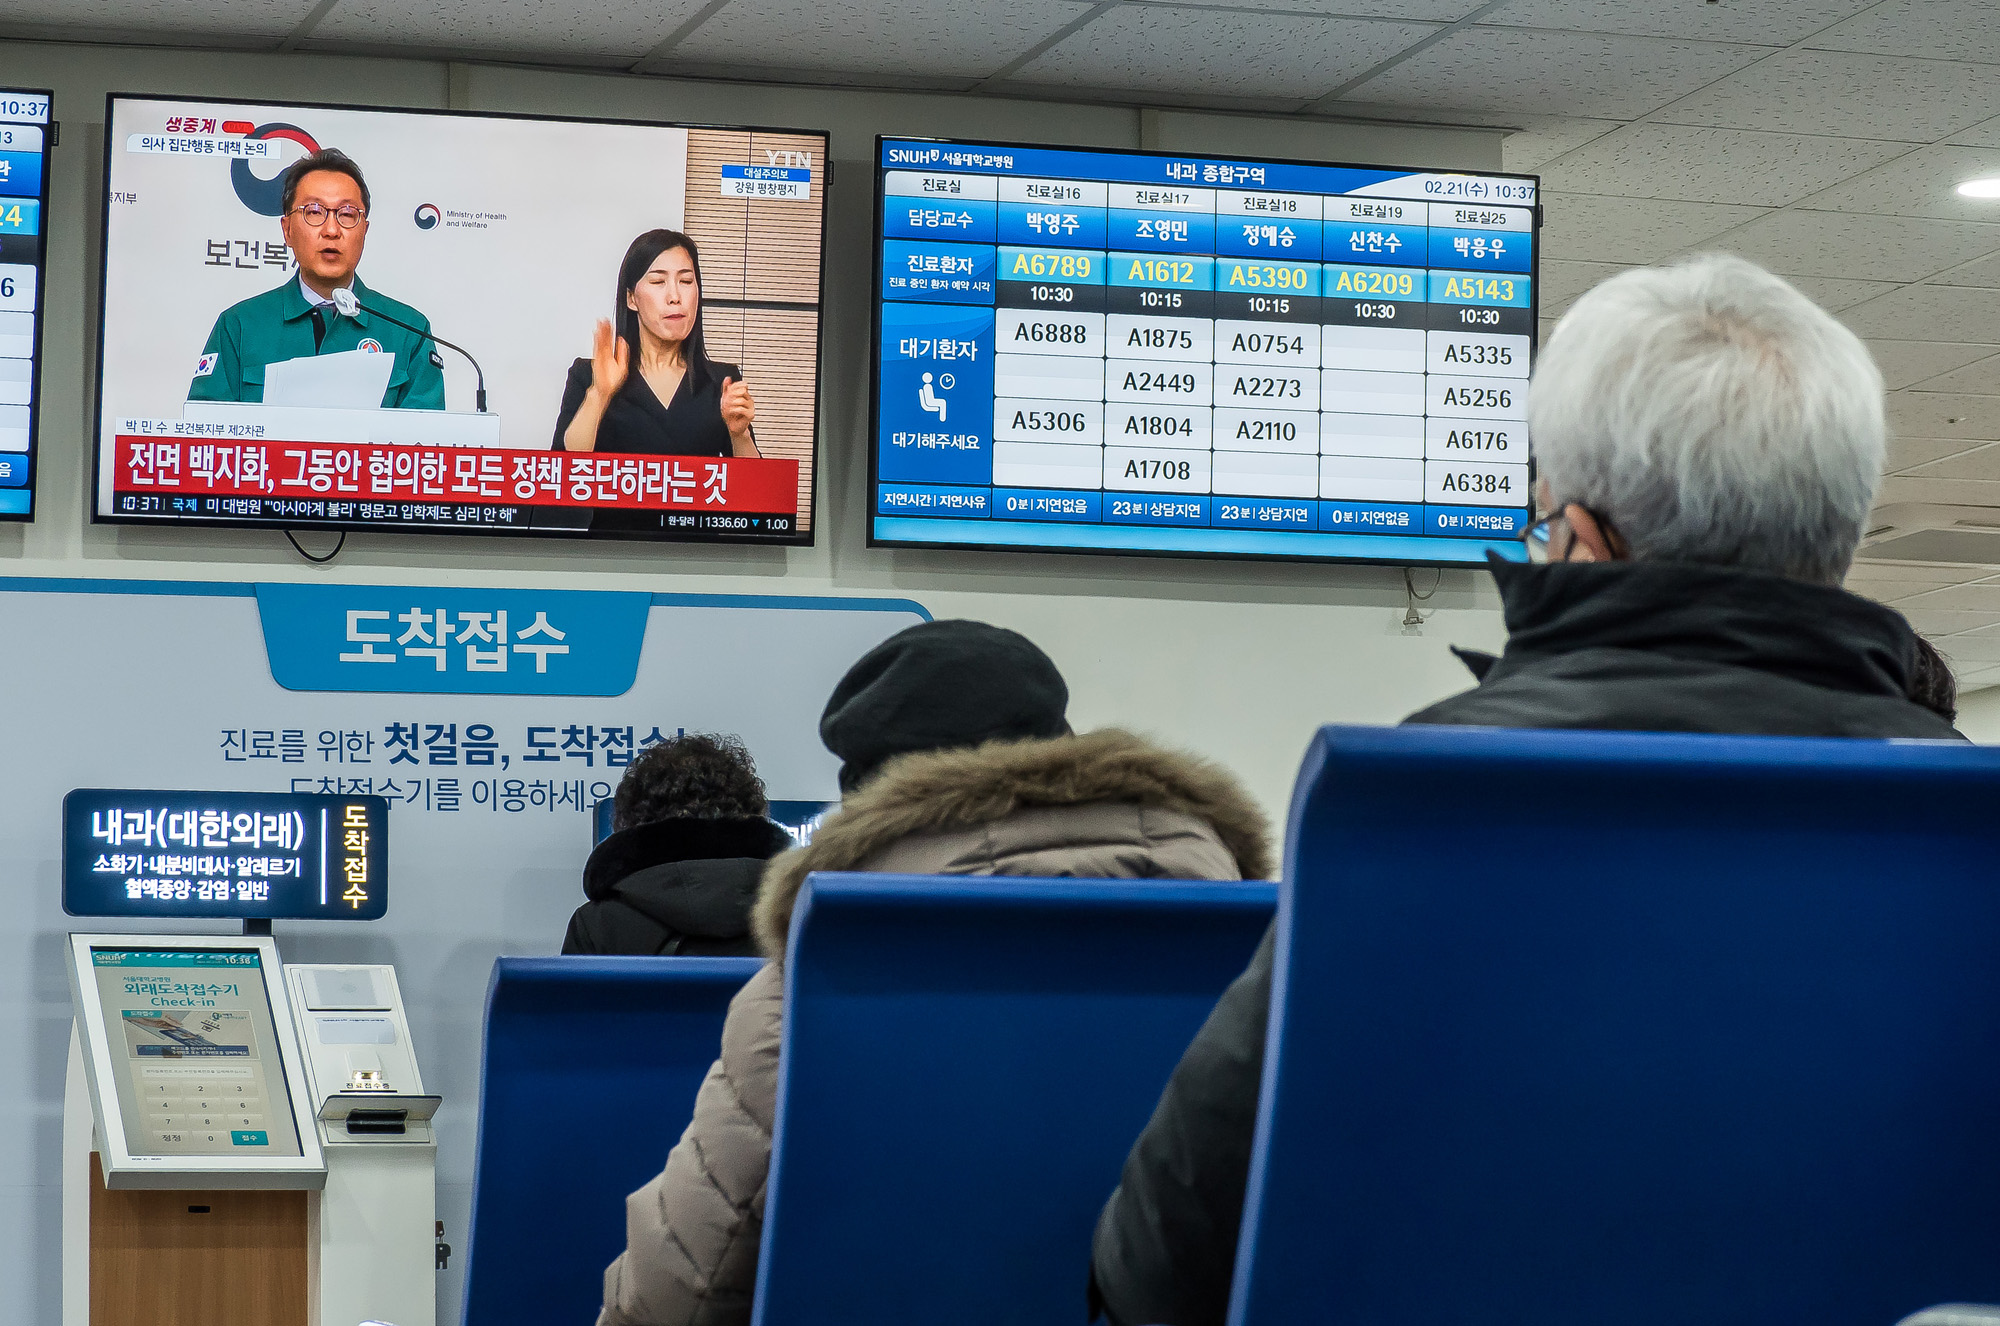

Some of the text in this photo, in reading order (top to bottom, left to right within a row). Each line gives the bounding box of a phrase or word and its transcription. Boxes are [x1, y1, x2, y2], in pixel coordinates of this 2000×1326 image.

[0, 101, 47, 116] 10:37
[165, 116, 217, 134] 생중계
[141, 137, 267, 156] 의사 집단행동 대책 논의
[765, 149, 811, 168] YTN
[889, 149, 1013, 168] SNUH 서울대학교병원
[744, 167, 788, 180] 대설주의보
[1166, 163, 1265, 185] 내과 종합구역
[734, 181, 797, 196] 강원 평창평지
[922, 178, 961, 193] 진료실
[1026, 183, 1080, 200] 진료실16
[1425, 180, 1535, 199] 02.21(수) 10:37
[1136, 189, 1189, 205] 진료실17
[1243, 197, 1297, 213] 진료실18
[446, 209, 507, 220] Ministry of Health
[909, 209, 973, 229] 담당교수
[1350, 203, 1403, 219] 진료실19
[1454, 209, 1506, 225] 진료실25
[461, 220, 488, 229] Welfare
[1026, 212, 1080, 236] 박영주
[1135, 219, 1188, 241] 조영민
[1243, 224, 1296, 247] 정혜승
[1349, 231, 1402, 253] 신찬수
[204, 239, 299, 271] 보건복
[1454, 237, 1506, 259] 박흥우
[907, 255, 974, 275] 진료환자
[1013, 254, 1091, 277] A6789
[1128, 260, 1193, 283] A1612
[889, 277, 990, 292] 진료 중인 환자 예약 시각
[1229, 266, 1307, 289] A5390
[1336, 271, 1413, 295] A6209
[1030, 286, 1073, 302] 10:30
[1444, 278, 1514, 301] A5143
[1140, 292, 1182, 307] 10:15
[1248, 298, 1289, 313] 10:15
[1354, 303, 1396, 319] 10:30
[1459, 309, 1500, 325] 10:30
[1015, 323, 1086, 344] A6888
[1127, 328, 1192, 349] A1875
[900, 338, 978, 361] 대기환자
[1232, 333, 1304, 354] A0754
[1444, 344, 1512, 365] A5335
[1123, 372, 1195, 393] A2449
[1232, 377, 1301, 398] A2273
[1443, 387, 1511, 408] A5256
[174, 422, 225, 436] 보건복지부
[227, 423, 265, 438] 제2차관
[1012, 411, 1086, 432] A5306
[1124, 416, 1193, 437] A1804
[1236, 420, 1296, 441] A2110
[892, 432, 980, 451] 대기해주세요
[1446, 430, 1508, 451] A6176
[128, 442, 728, 505] 전면 백지화, 그동안 협의한 모든 정책 중단하라는 것
[1124, 459, 1190, 480] A1708
[1442, 473, 1511, 494] A6384
[122, 497, 159, 510] 10:37
[172, 498, 198, 511] 국제
[206, 498, 219, 513] 미
[223, 499, 261, 515] 대법원
[327, 501, 356, 518] 불리'
[360, 502, 398, 518] 명문고
[402, 504, 452, 521] 입학제도
[455, 506, 480, 522] 심리
[484, 507, 497, 521] 안
[884, 493, 986, 509] 지연시간 지연사유
[1007, 497, 1087, 514] 0분 지연없음
[1112, 501, 1201, 518] 23분 상담지연
[668, 515, 788, 530] 원-달러 1336.60 1.00
[1221, 505, 1308, 522] 23분 상담지연
[1332, 509, 1409, 527] 0분 지연없음
[1438, 514, 1514, 531] 0분 지연없음
[339, 607, 570, 674] 도착접수
[220, 728, 308, 763] 진료를
[316, 729, 375, 763] 위한
[383, 722, 510, 770] 첫걸음,
[91, 808, 305, 851] 내과(대한외래)
[342, 805, 370, 909] 도착접수
[224, 957, 251, 965] 10:38
[124, 983, 239, 996] 외래도착접수기
[150, 997, 215, 1007] Check-in
